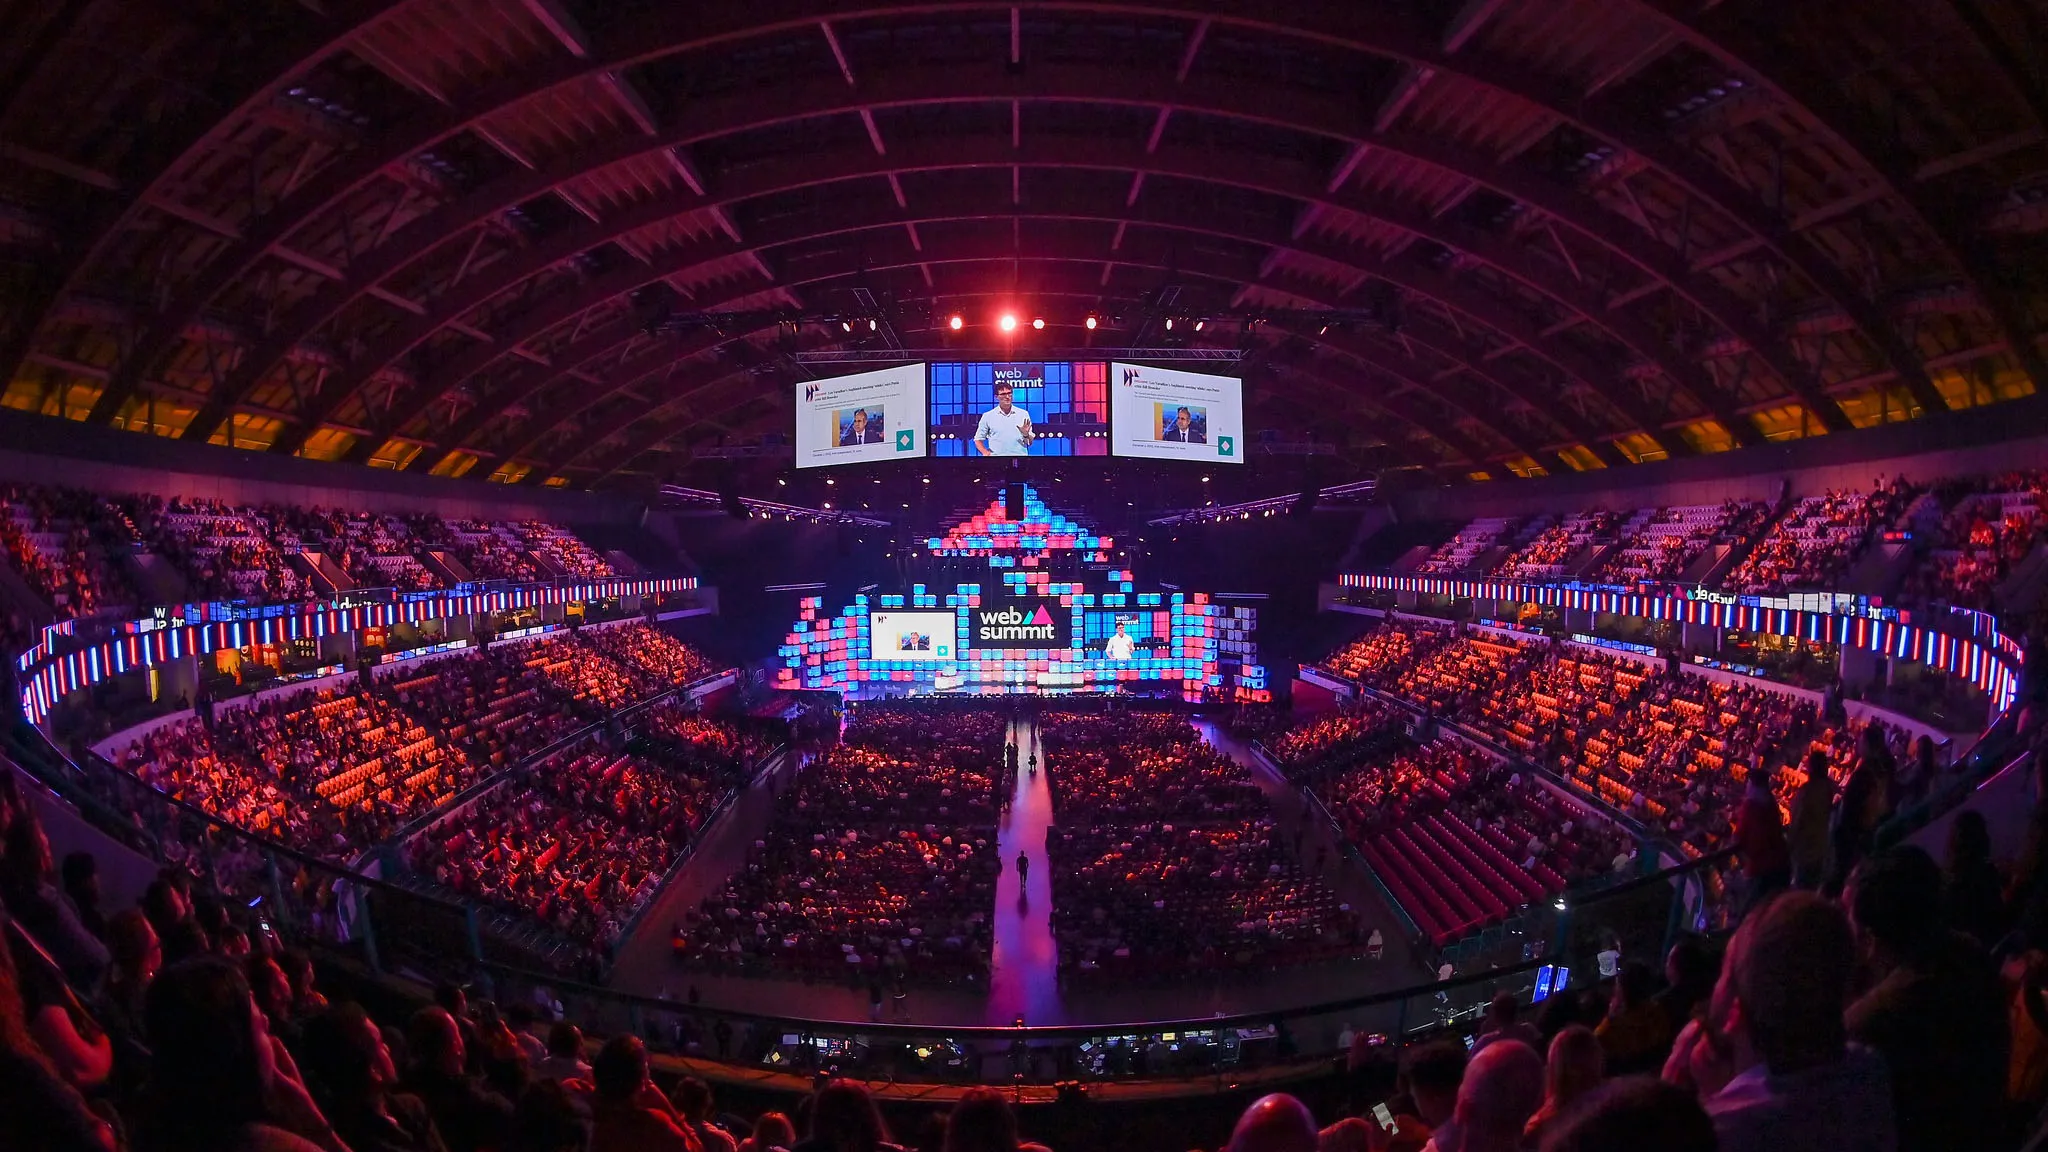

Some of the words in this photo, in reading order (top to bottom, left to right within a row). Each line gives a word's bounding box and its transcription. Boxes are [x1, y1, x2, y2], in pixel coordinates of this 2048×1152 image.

[994, 367, 1022, 379] web
[994, 377, 1043, 388] smmit
[980, 605, 1022, 624] web
[980, 623, 1055, 639] summit
